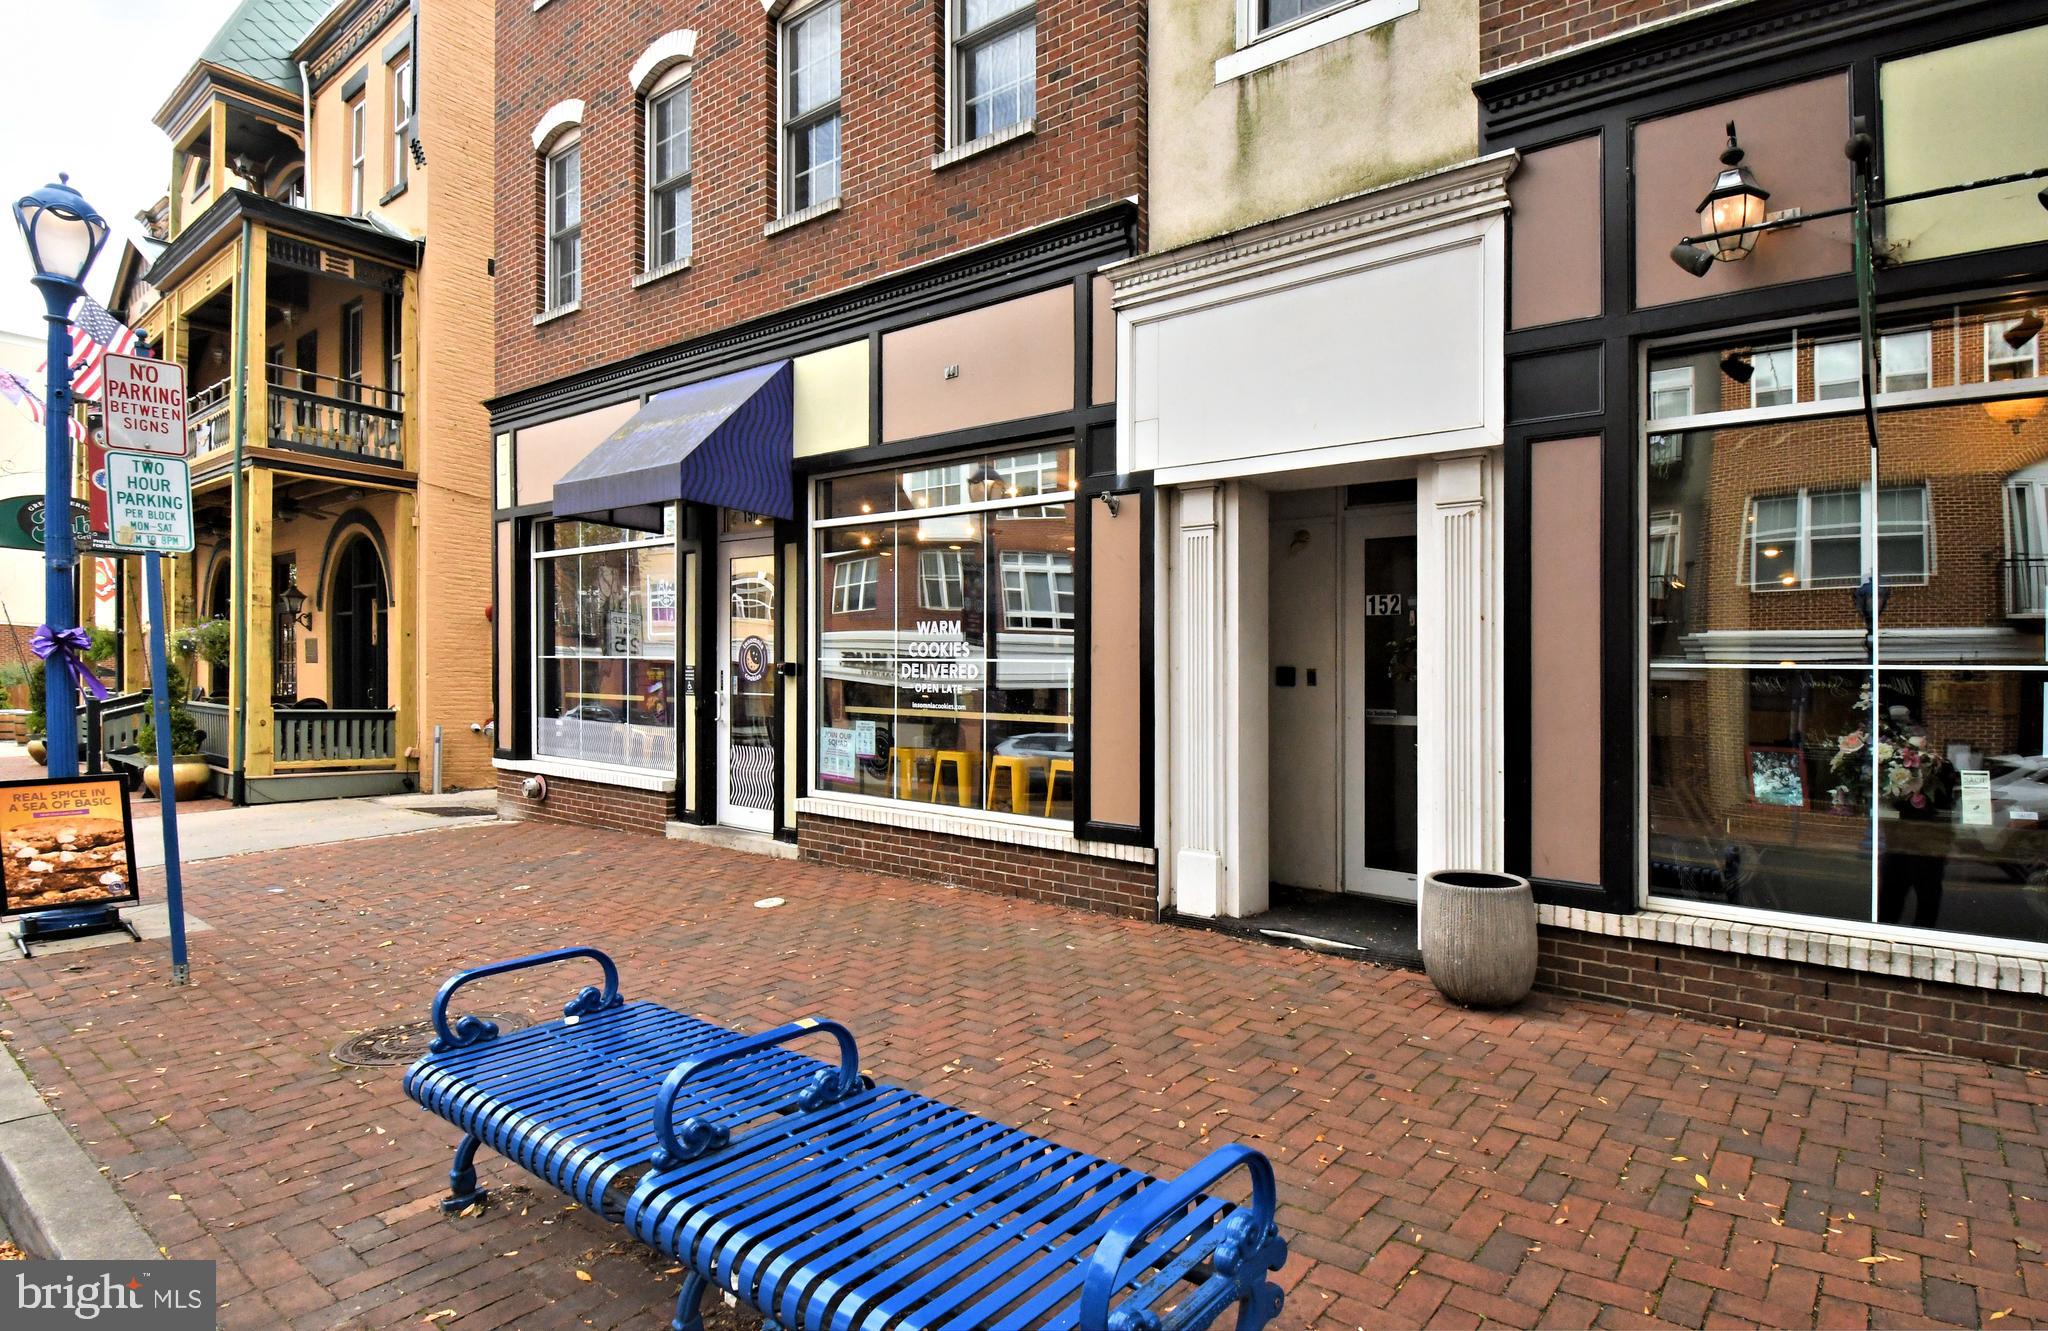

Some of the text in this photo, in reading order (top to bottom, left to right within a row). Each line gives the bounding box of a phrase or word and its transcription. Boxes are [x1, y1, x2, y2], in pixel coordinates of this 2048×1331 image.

[130, 363, 158, 383] NO
[109, 380, 180, 406] PARKING
[110, 401, 180, 421] BETWEEN
[124, 417, 169, 434] SIGNS
[132, 460, 164, 475] TWO
[128, 476, 170, 492] HOUR
[117, 491, 183, 510] PARKING
[125, 509, 176, 521] PER BLOCK
[1368, 595, 1400, 615] 152
[916, 620, 961, 635] WARM
[908, 641, 970, 657] COOKIES
[901, 663, 979, 679] DELIVERED
[914, 683, 963, 694] OPEN LATE
[13, 788, 105, 802] REAL SPICE IN
[9, 797, 112, 812] A SEA OF BASIC
